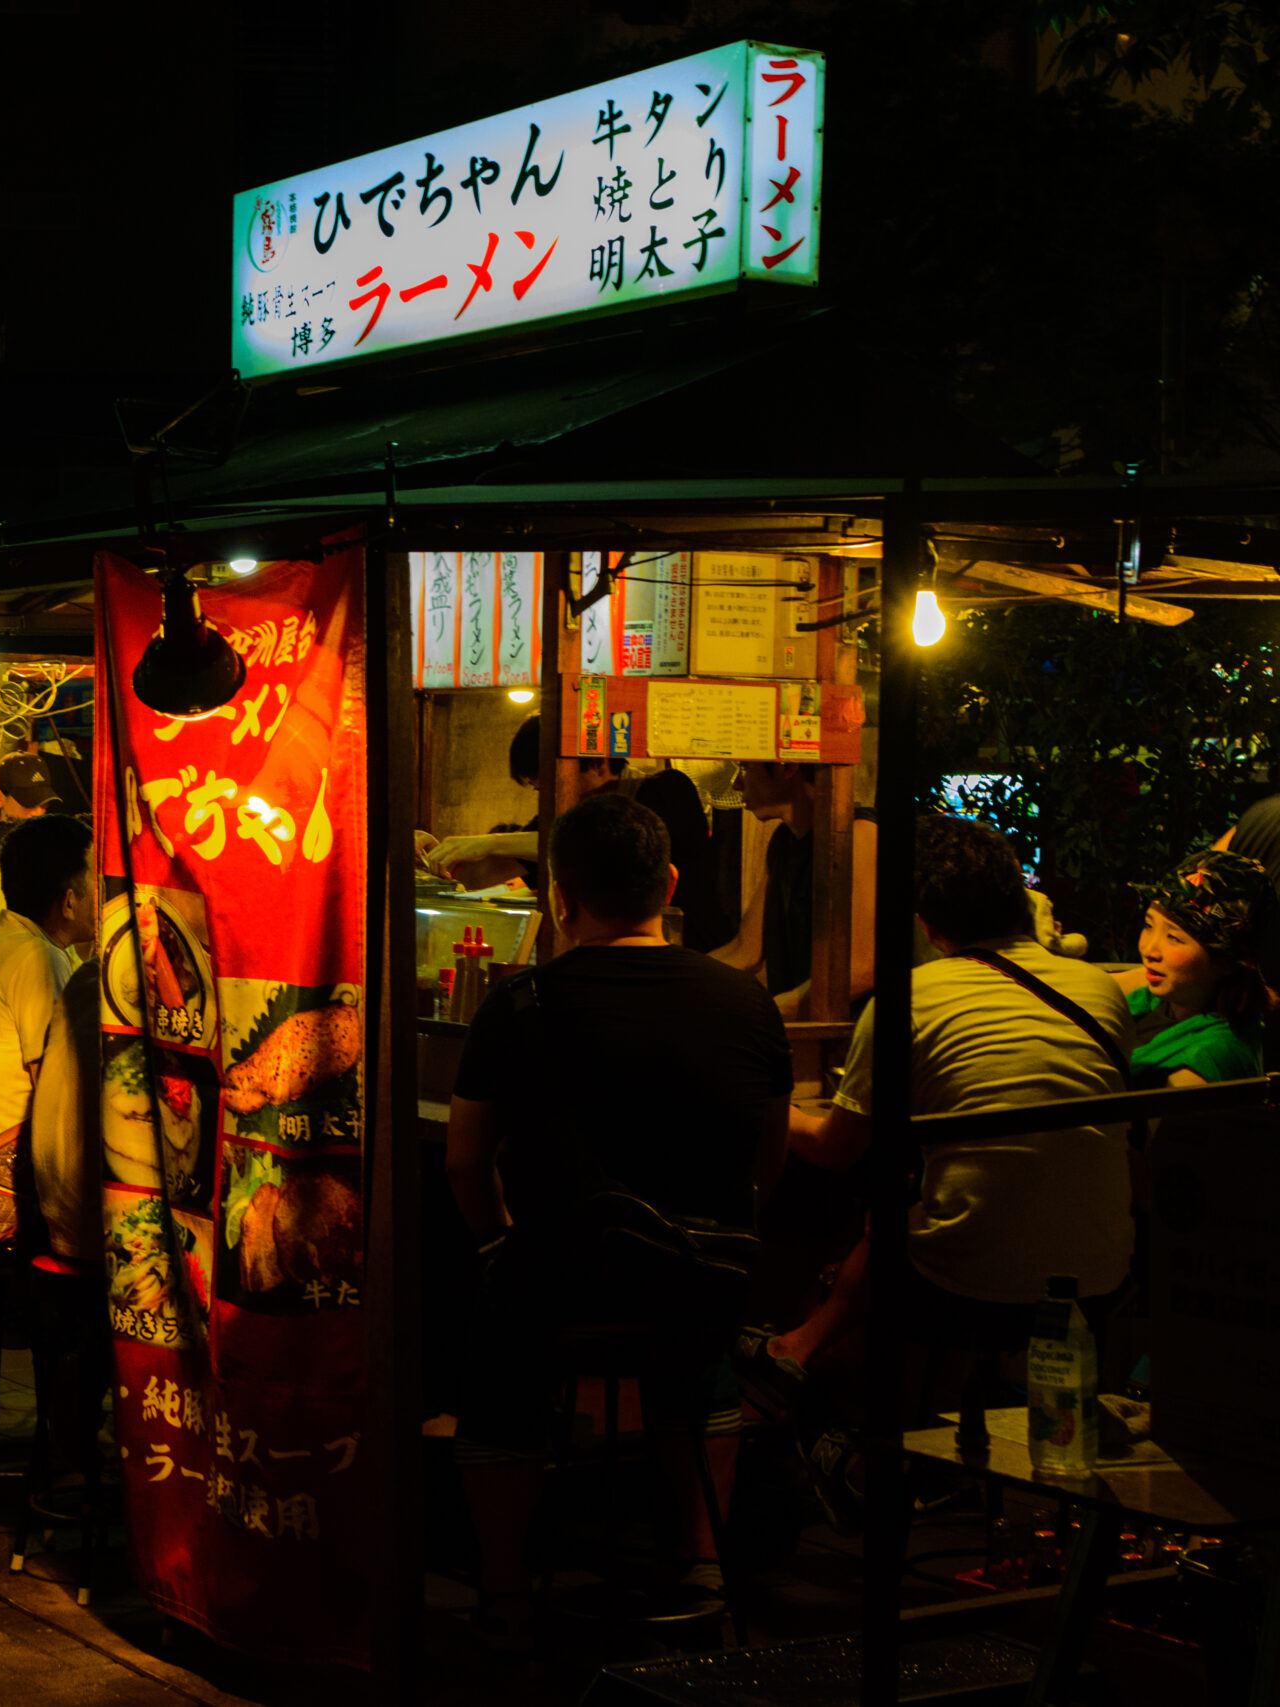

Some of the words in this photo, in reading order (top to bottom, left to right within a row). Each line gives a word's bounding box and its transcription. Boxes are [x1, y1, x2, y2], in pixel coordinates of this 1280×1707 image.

[592, 82, 729, 162] 牛タン
[761, 59, 807, 271] ラーメン
[313, 122, 565, 256] ひでちゃん
[593, 137, 727, 225] 焼とり
[349, 230, 560, 348] ラーメン
[589, 208, 726, 293] 明太子
[291, 316, 336, 358] 博多
[156, 1003, 204, 1039] 串焼き
[278, 1110, 365, 1143] 明太子
[142, 1375, 361, 1475] 純豚生スープ
